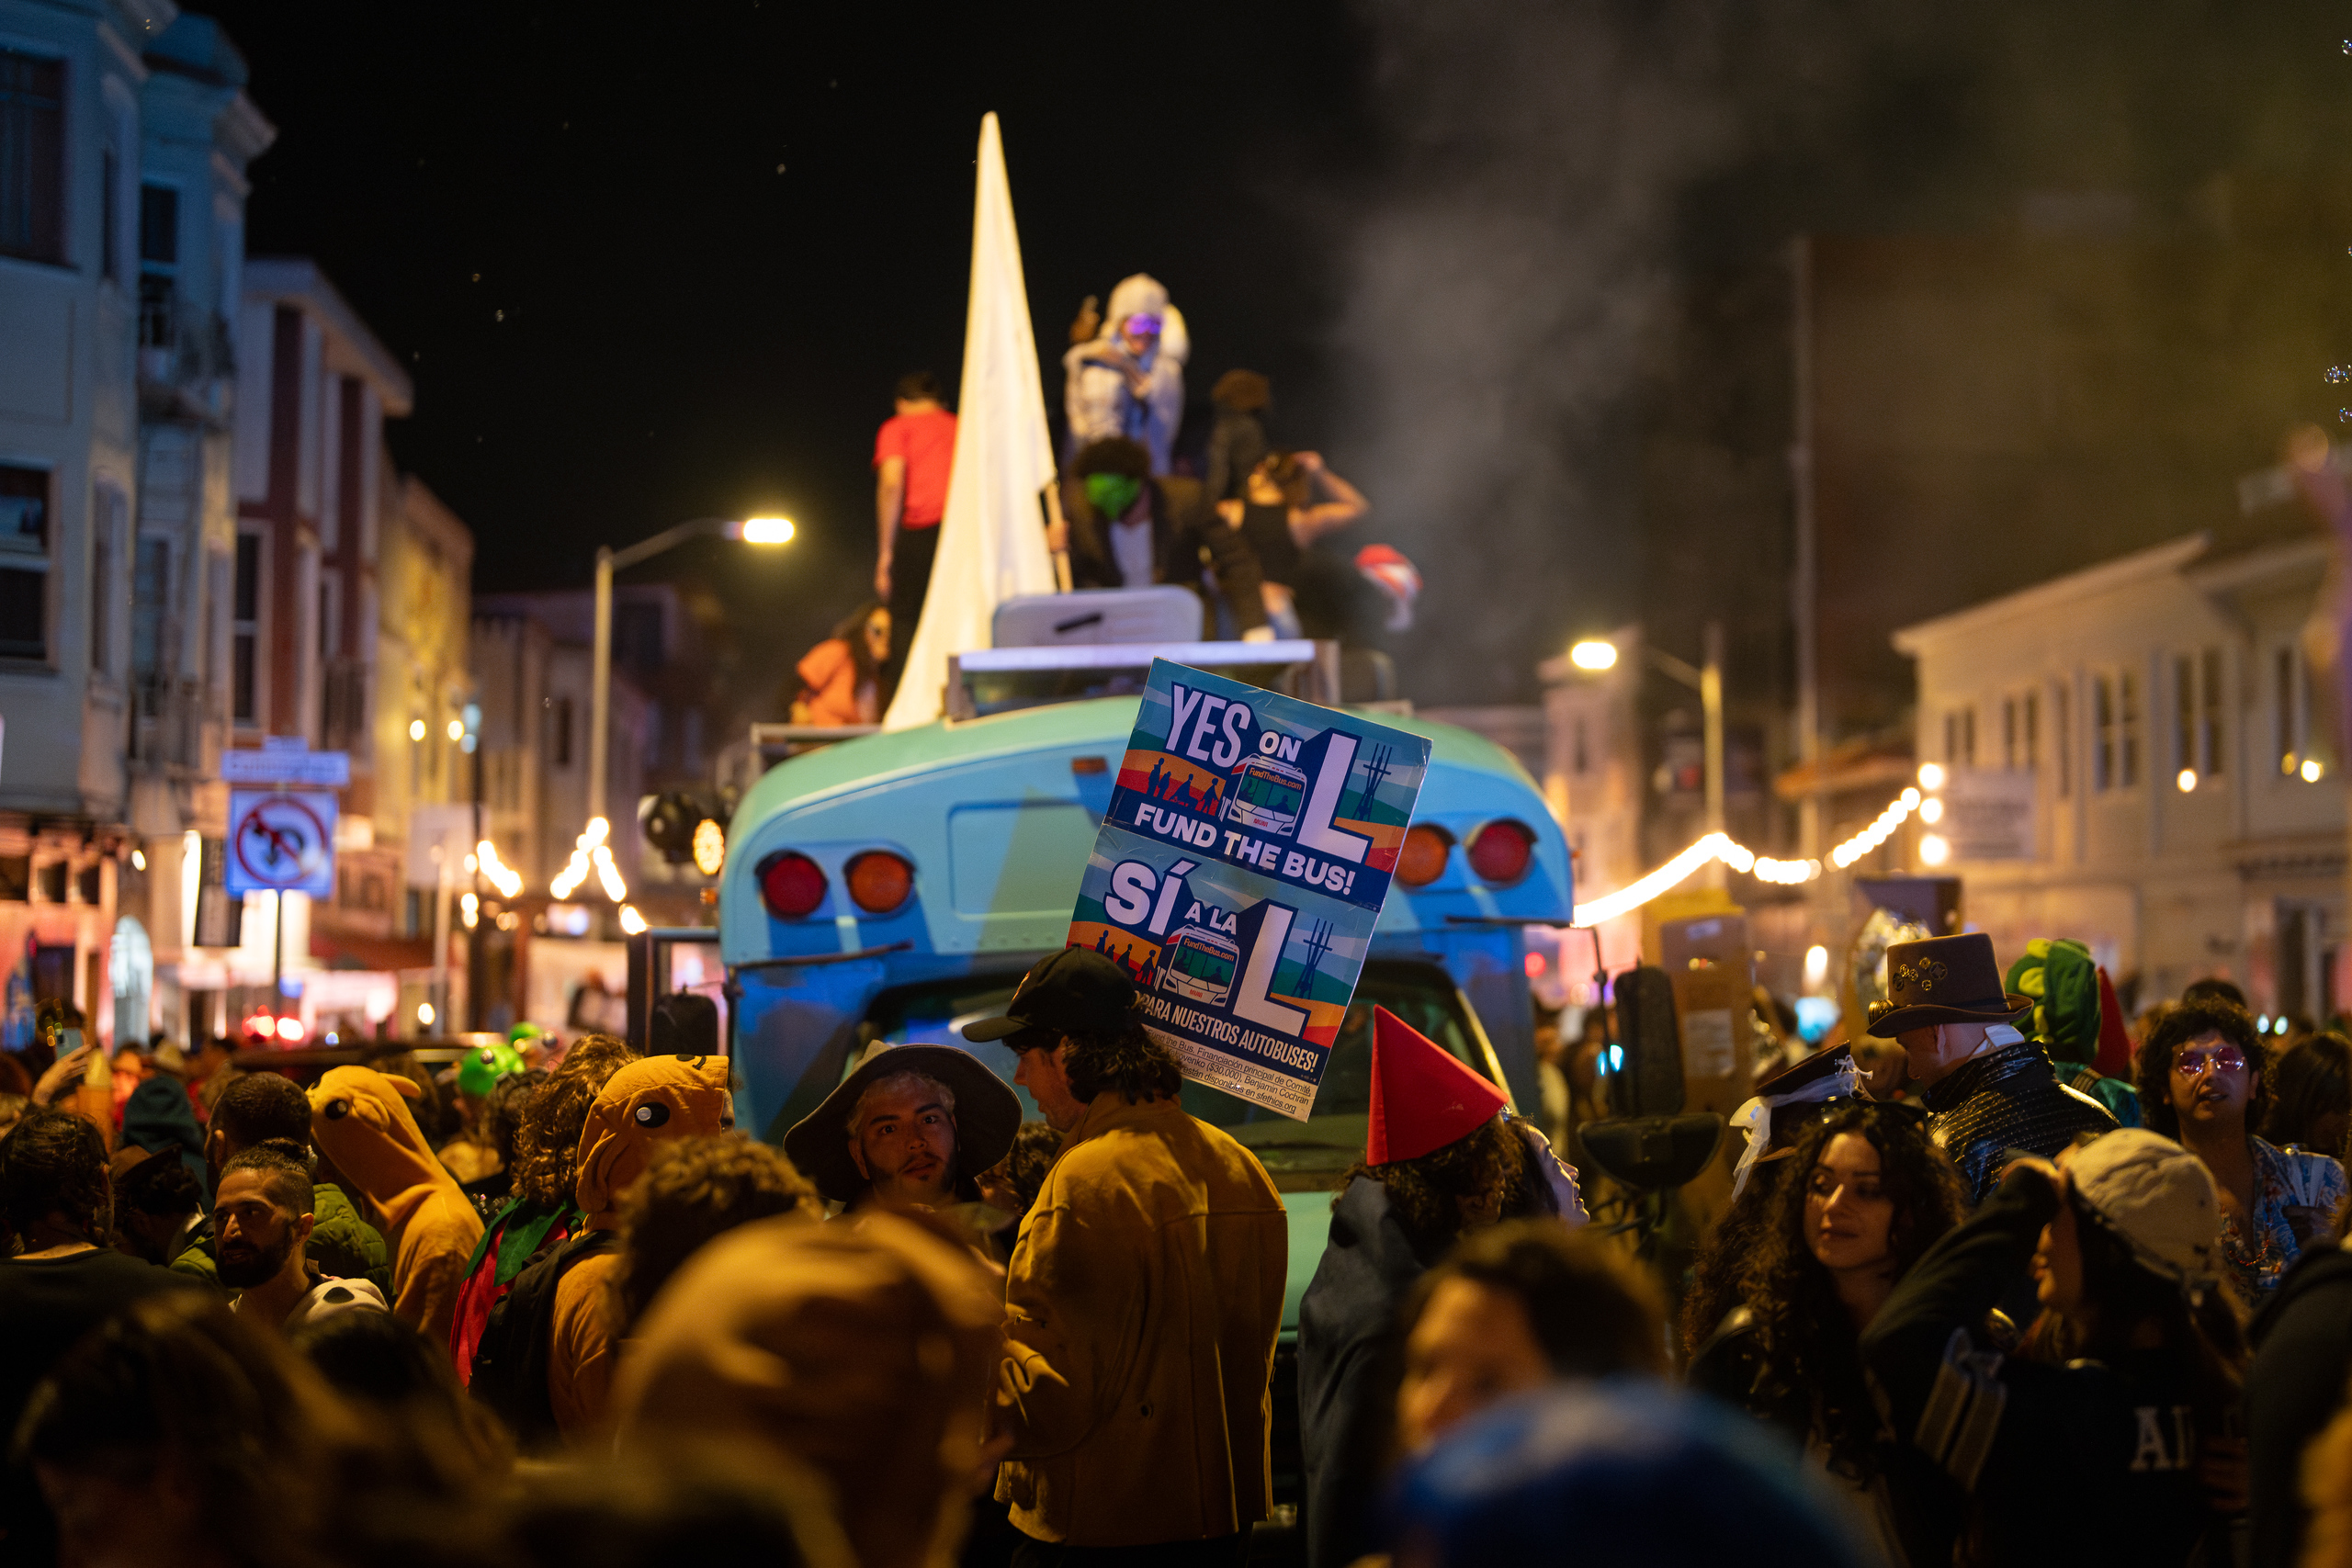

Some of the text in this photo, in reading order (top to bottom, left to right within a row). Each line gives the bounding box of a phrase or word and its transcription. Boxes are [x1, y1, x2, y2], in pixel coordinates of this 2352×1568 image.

[1165, 684, 1368, 863] YES ON L
[1249, 766, 1303, 791] FundTheBus.com
[1134, 802, 1356, 896] FUND THE BUS!
[1105, 860, 1306, 1037] SÍ A LA L
[1183, 937, 1235, 962] FundTheBus.com
[1140, 993, 1171, 1021] PARA
[1170, 1005, 1240, 1045] NUESTROS
[1238, 1029, 1319, 1073] AUTOBUSES!
[1166, 1037, 1178, 1047] the
[1179, 1041, 1194, 1054] Bus.
[1196, 1047, 1243, 1069] Financiación
[1243, 1066, 1274, 1082] principal
[1274, 1076, 1284, 1085] de
[1285, 1078, 1311, 1097] Comité,
[1182, 1066, 1296, 1113] están disponibles en sfethics.org
[1244, 1076, 1278, 1094] Benjamin
[1279, 1088, 1309, 1105] Cochran
